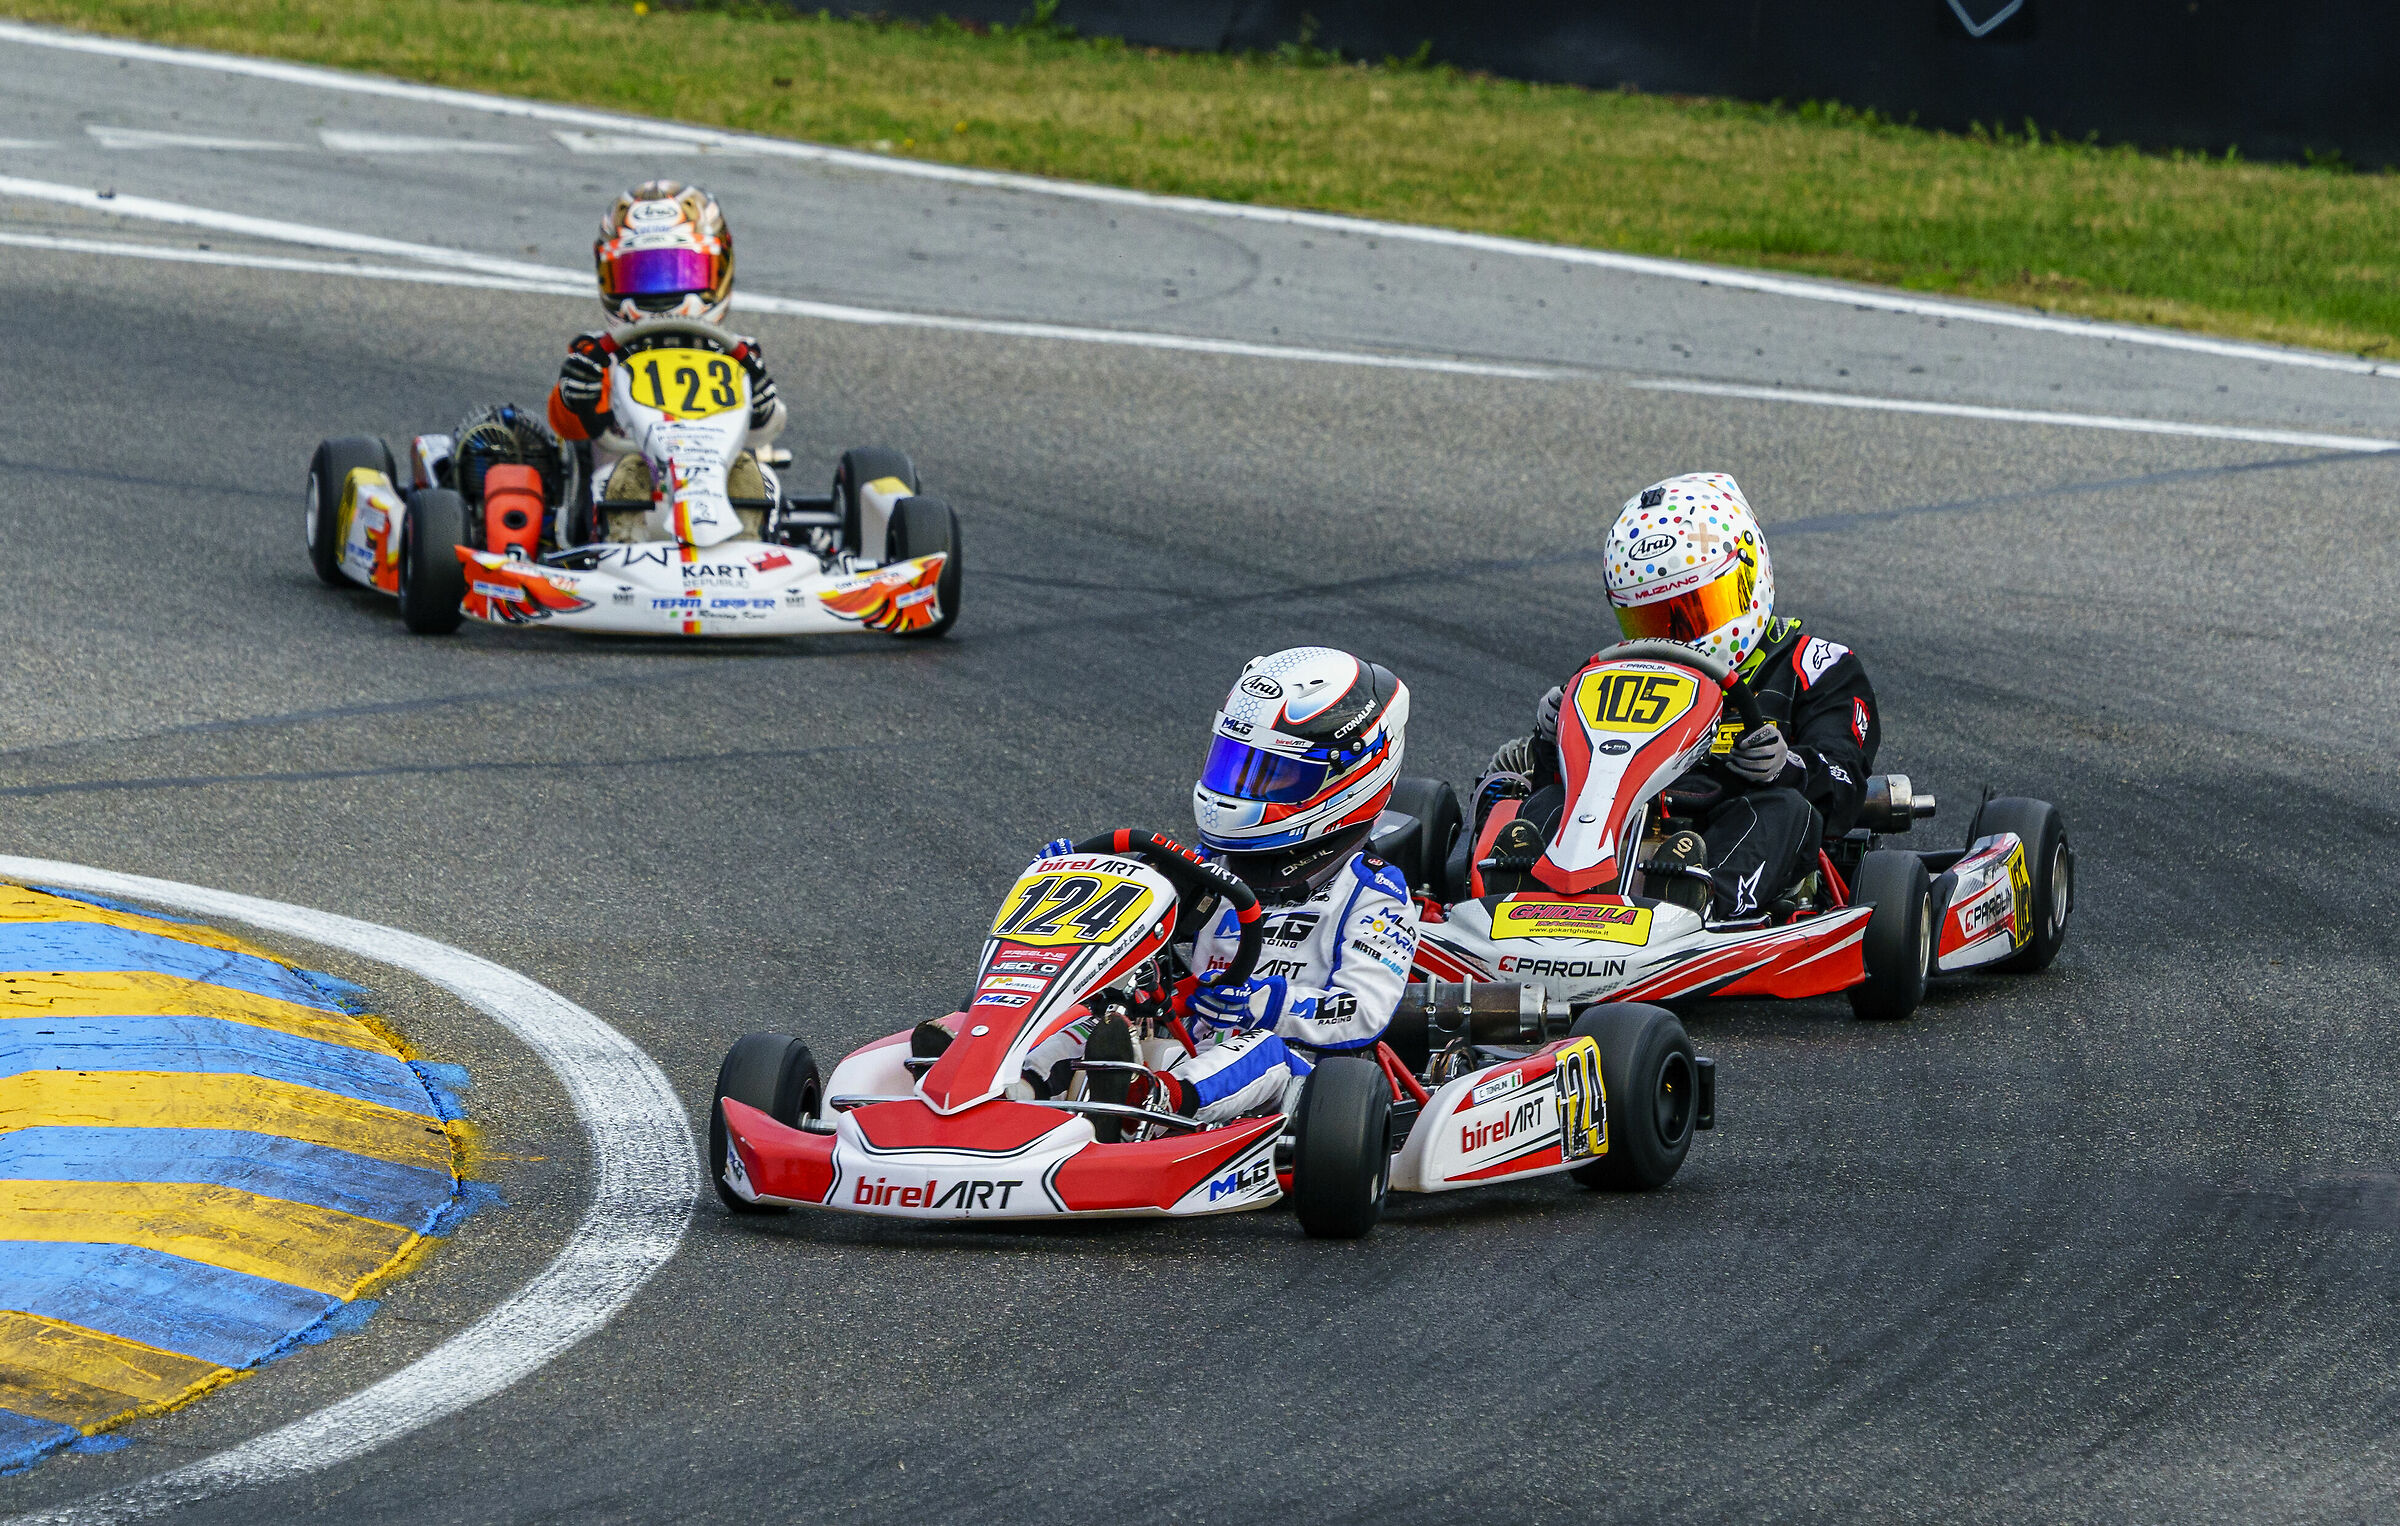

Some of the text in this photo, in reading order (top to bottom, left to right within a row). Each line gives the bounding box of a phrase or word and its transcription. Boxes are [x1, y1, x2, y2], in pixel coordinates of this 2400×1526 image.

[645, 359, 737, 412] 123
[1632, 535, 1669, 558] Arai
[681, 565, 748, 579] KART
[652, 598, 702, 609] TEAM
[1243, 676, 1280, 696] Arai
[1596, 675, 1680, 725] 105
[1222, 716, 1254, 735] MLG
[992, 875, 1149, 941] 124
[1508, 904, 1638, 925] GHIDELLA
[1529, 927, 1609, 936] www.gokartghidella.it
[1535, 920, 1606, 929] RACING
[1261, 939, 1299, 949] ACING
[1352, 939, 1382, 961] MISTER
[1002, 949, 1067, 960] FREELINE
[976, 995, 1032, 1006] MLG
[1290, 991, 1358, 1020] MLG
[1318, 1016, 1352, 1025] RACING
[1554, 1045, 1607, 1163] 124
[1210, 1157, 1270, 1202] MLG
